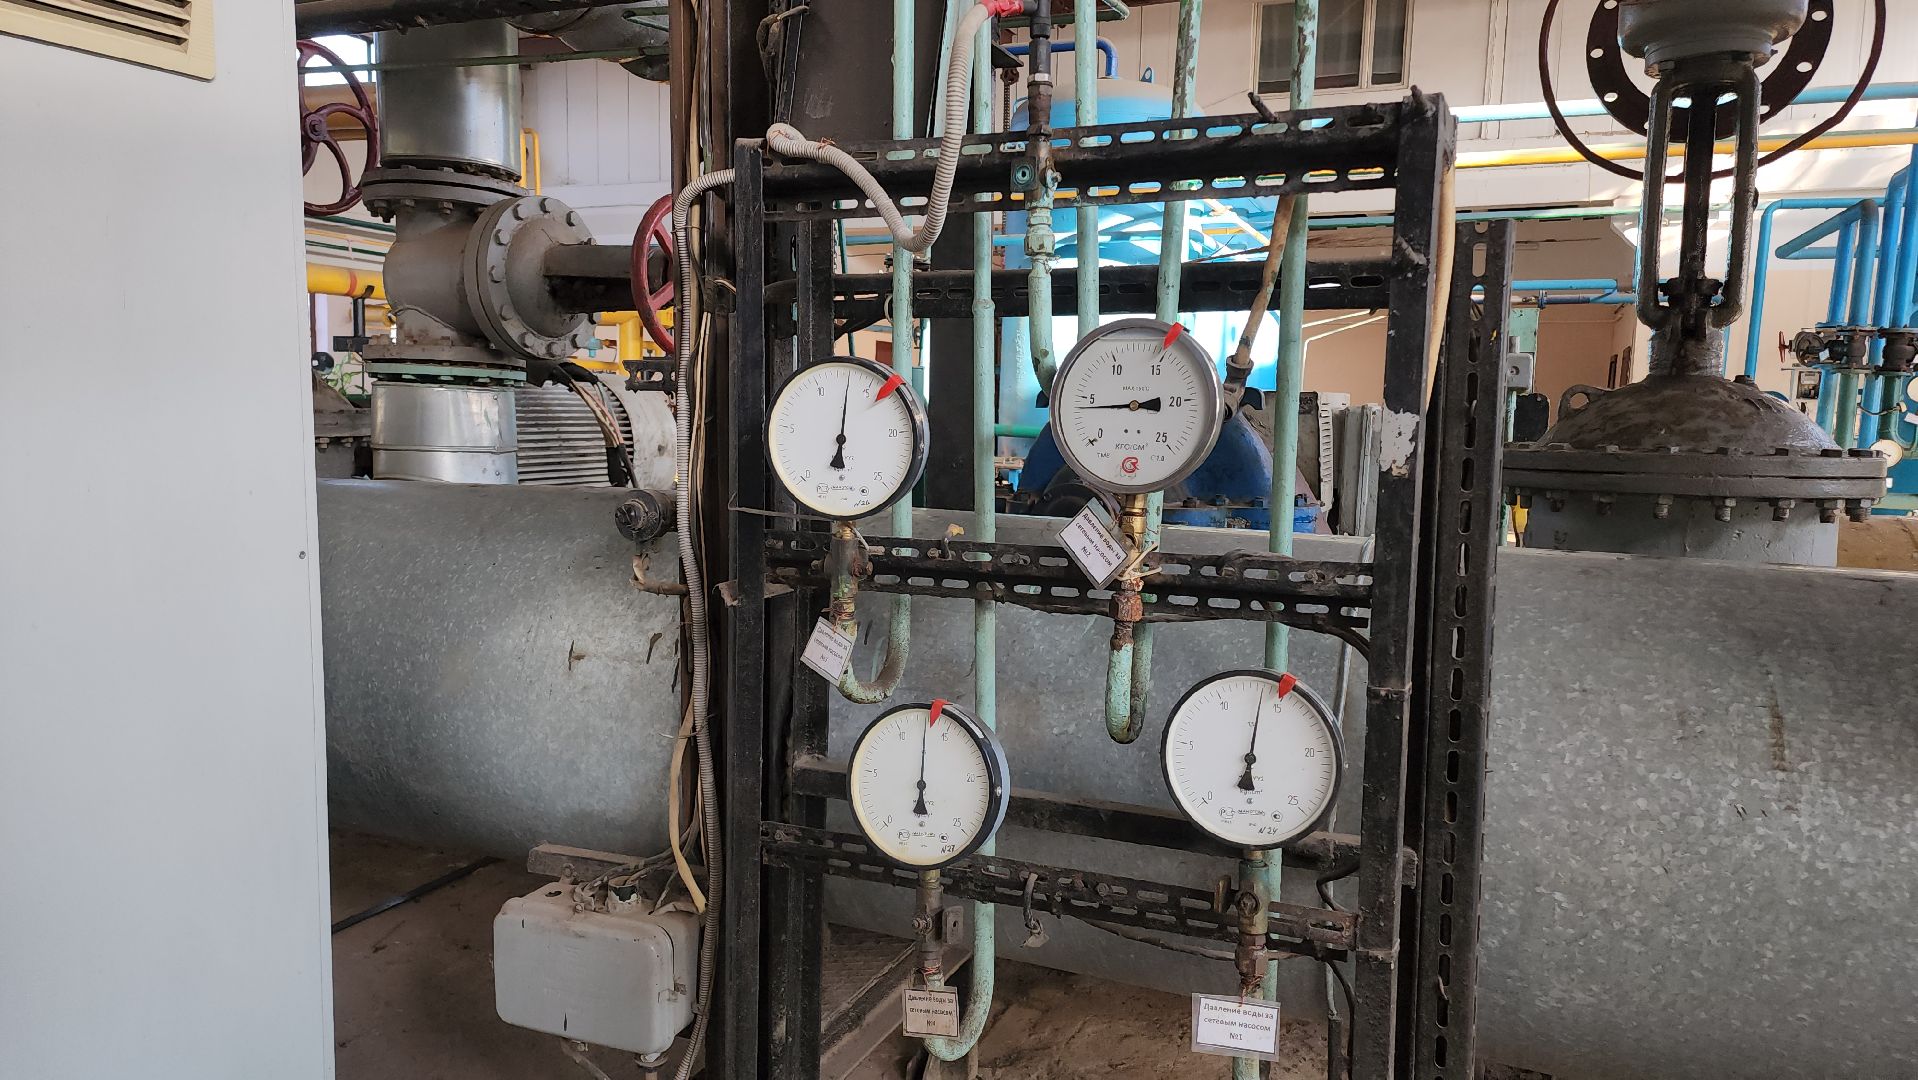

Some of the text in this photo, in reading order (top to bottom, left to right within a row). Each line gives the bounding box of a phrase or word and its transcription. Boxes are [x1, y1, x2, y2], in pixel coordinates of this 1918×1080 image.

[1111, 364, 1122, 376] 10
[1151, 364, 1161, 376] 15
[818, 387, 825, 397] 10
[1089, 394, 1095, 404] 5
[1169, 397, 1181, 407] 20
[790, 424, 795, 433] 5
[888, 428, 898, 438] 20
[1097, 428, 1103, 438] 0
[1156, 432, 1167, 443] 25
[806, 470, 811, 479] 0
[873, 472, 883, 481] 25
[1220, 701, 1229, 711] 10
[1273, 703, 1282, 714] 15
[899, 732, 905, 741] 10
[941, 733, 949, 742] 15
[1189, 740, 1194, 750] 5
[1305, 747, 1315, 758] 20
[873, 769, 878, 778] 5
[966, 773, 975, 782] 20
[1207, 791, 1213, 800] 0
[1288, 795, 1299, 806] 25
[888, 815, 892, 824] 0
[953, 817, 962, 827] 25
[1204, 1003, 1241, 1015] Давление
[1243, 1009, 1264, 1018] воды
[1204, 1017, 1271, 1032] сетевым насосом
